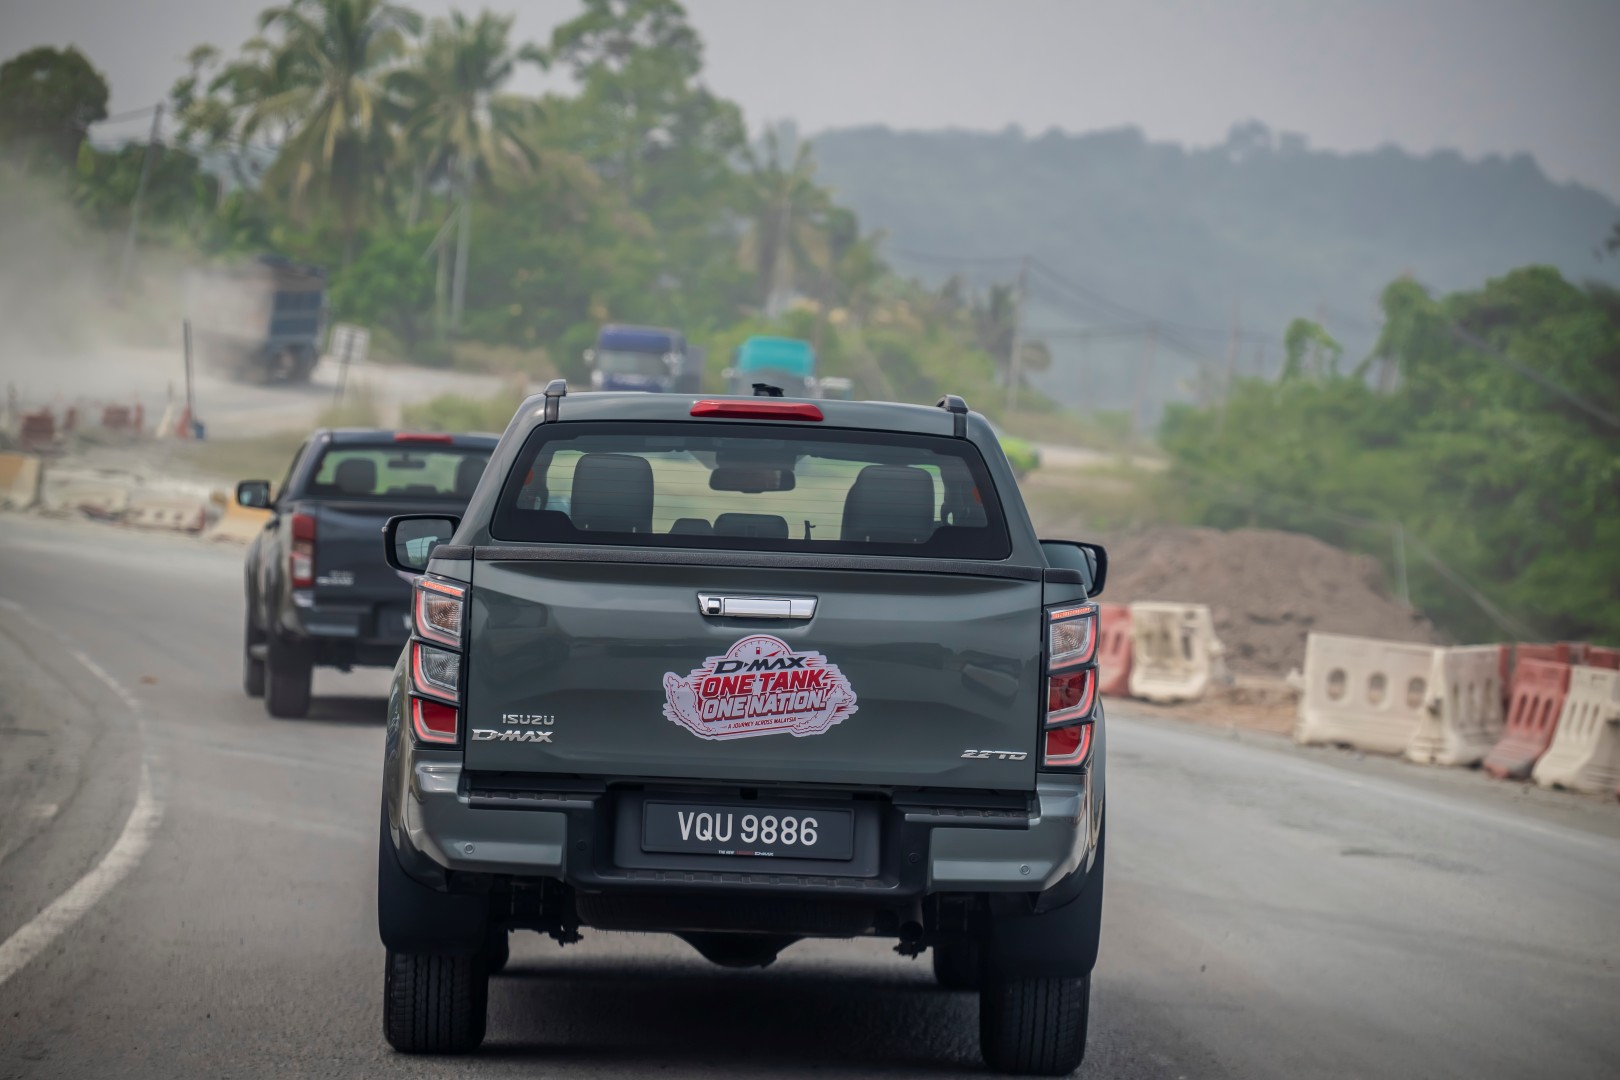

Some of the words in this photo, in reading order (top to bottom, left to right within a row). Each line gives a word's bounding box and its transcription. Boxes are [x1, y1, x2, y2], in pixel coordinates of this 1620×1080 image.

[702, 674, 755, 698] ONE
[502, 713, 555, 726] ISUZU
[701, 697, 750, 722] ONE
[733, 721, 754, 729] JOURNEY
[754, 718, 773, 726] ACROSS
[773, 716, 797, 724] MALAYSIA
[677, 811, 733, 842] VQU
[740, 814, 818, 846] 9886
